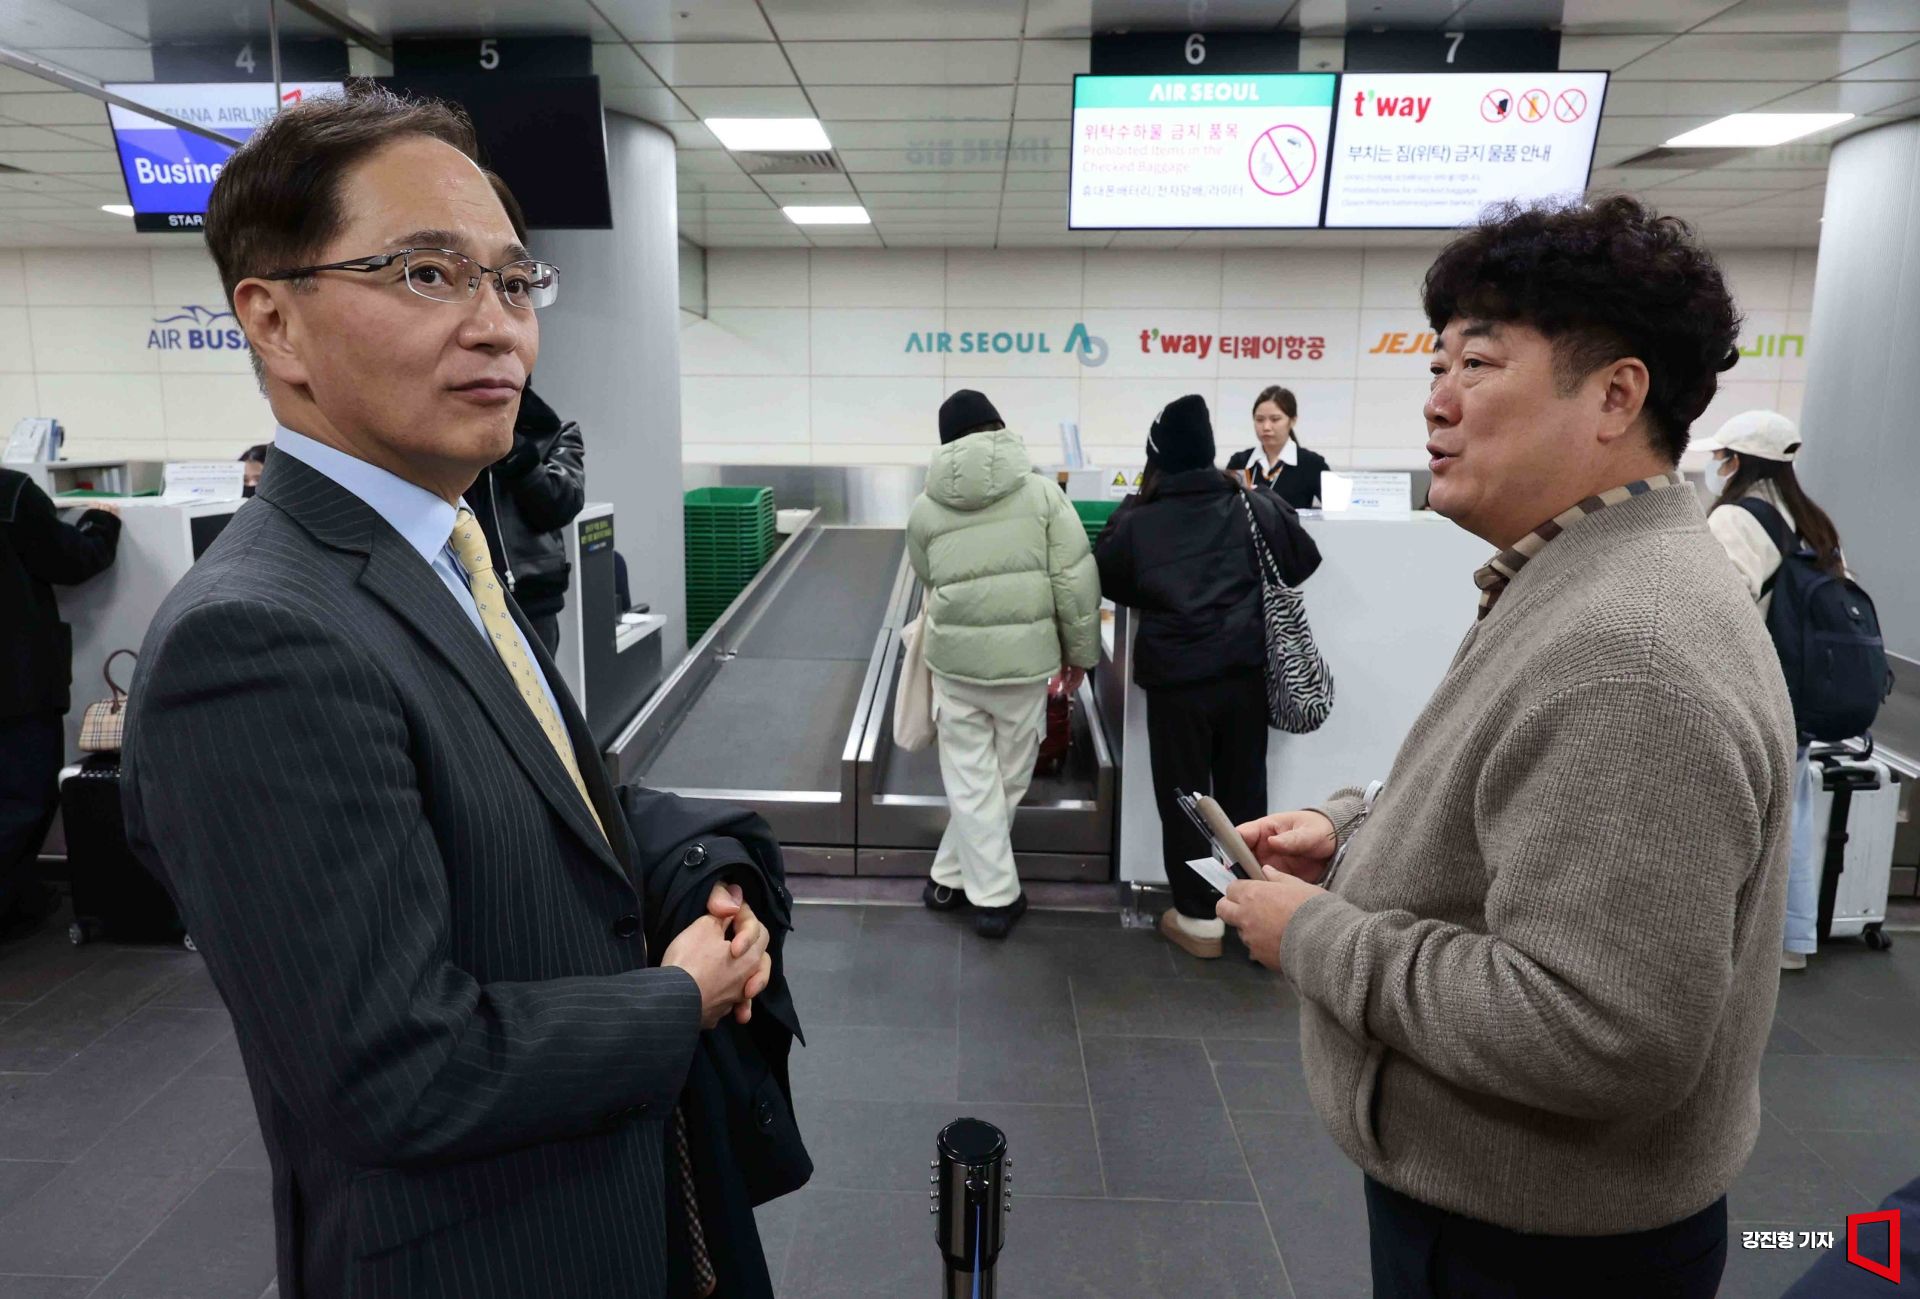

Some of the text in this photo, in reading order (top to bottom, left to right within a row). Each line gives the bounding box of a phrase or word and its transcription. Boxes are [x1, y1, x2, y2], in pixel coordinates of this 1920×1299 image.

[479, 39, 500, 70] 5
[1184, 33, 1207, 65] 6
[1444, 32, 1465, 63] 7
[236, 45, 255, 74] 4
[1149, 81, 1260, 103] AIR SEOUL
[1084, 123, 1240, 141] 위탁수하물 금지 품목
[1082, 144, 1148, 156] Prohibited
[1203, 144, 1224, 156] the
[1347, 144, 1552, 163] 부치는 짐(위탁) 금지 물품 안내
[1082, 161, 1191, 176] Checked Baggage
[147, 329, 250, 349] AIR BUS
[905, 331, 1050, 355] AIR SEOUL
[1219, 334, 1326, 361] 티웨이항공
